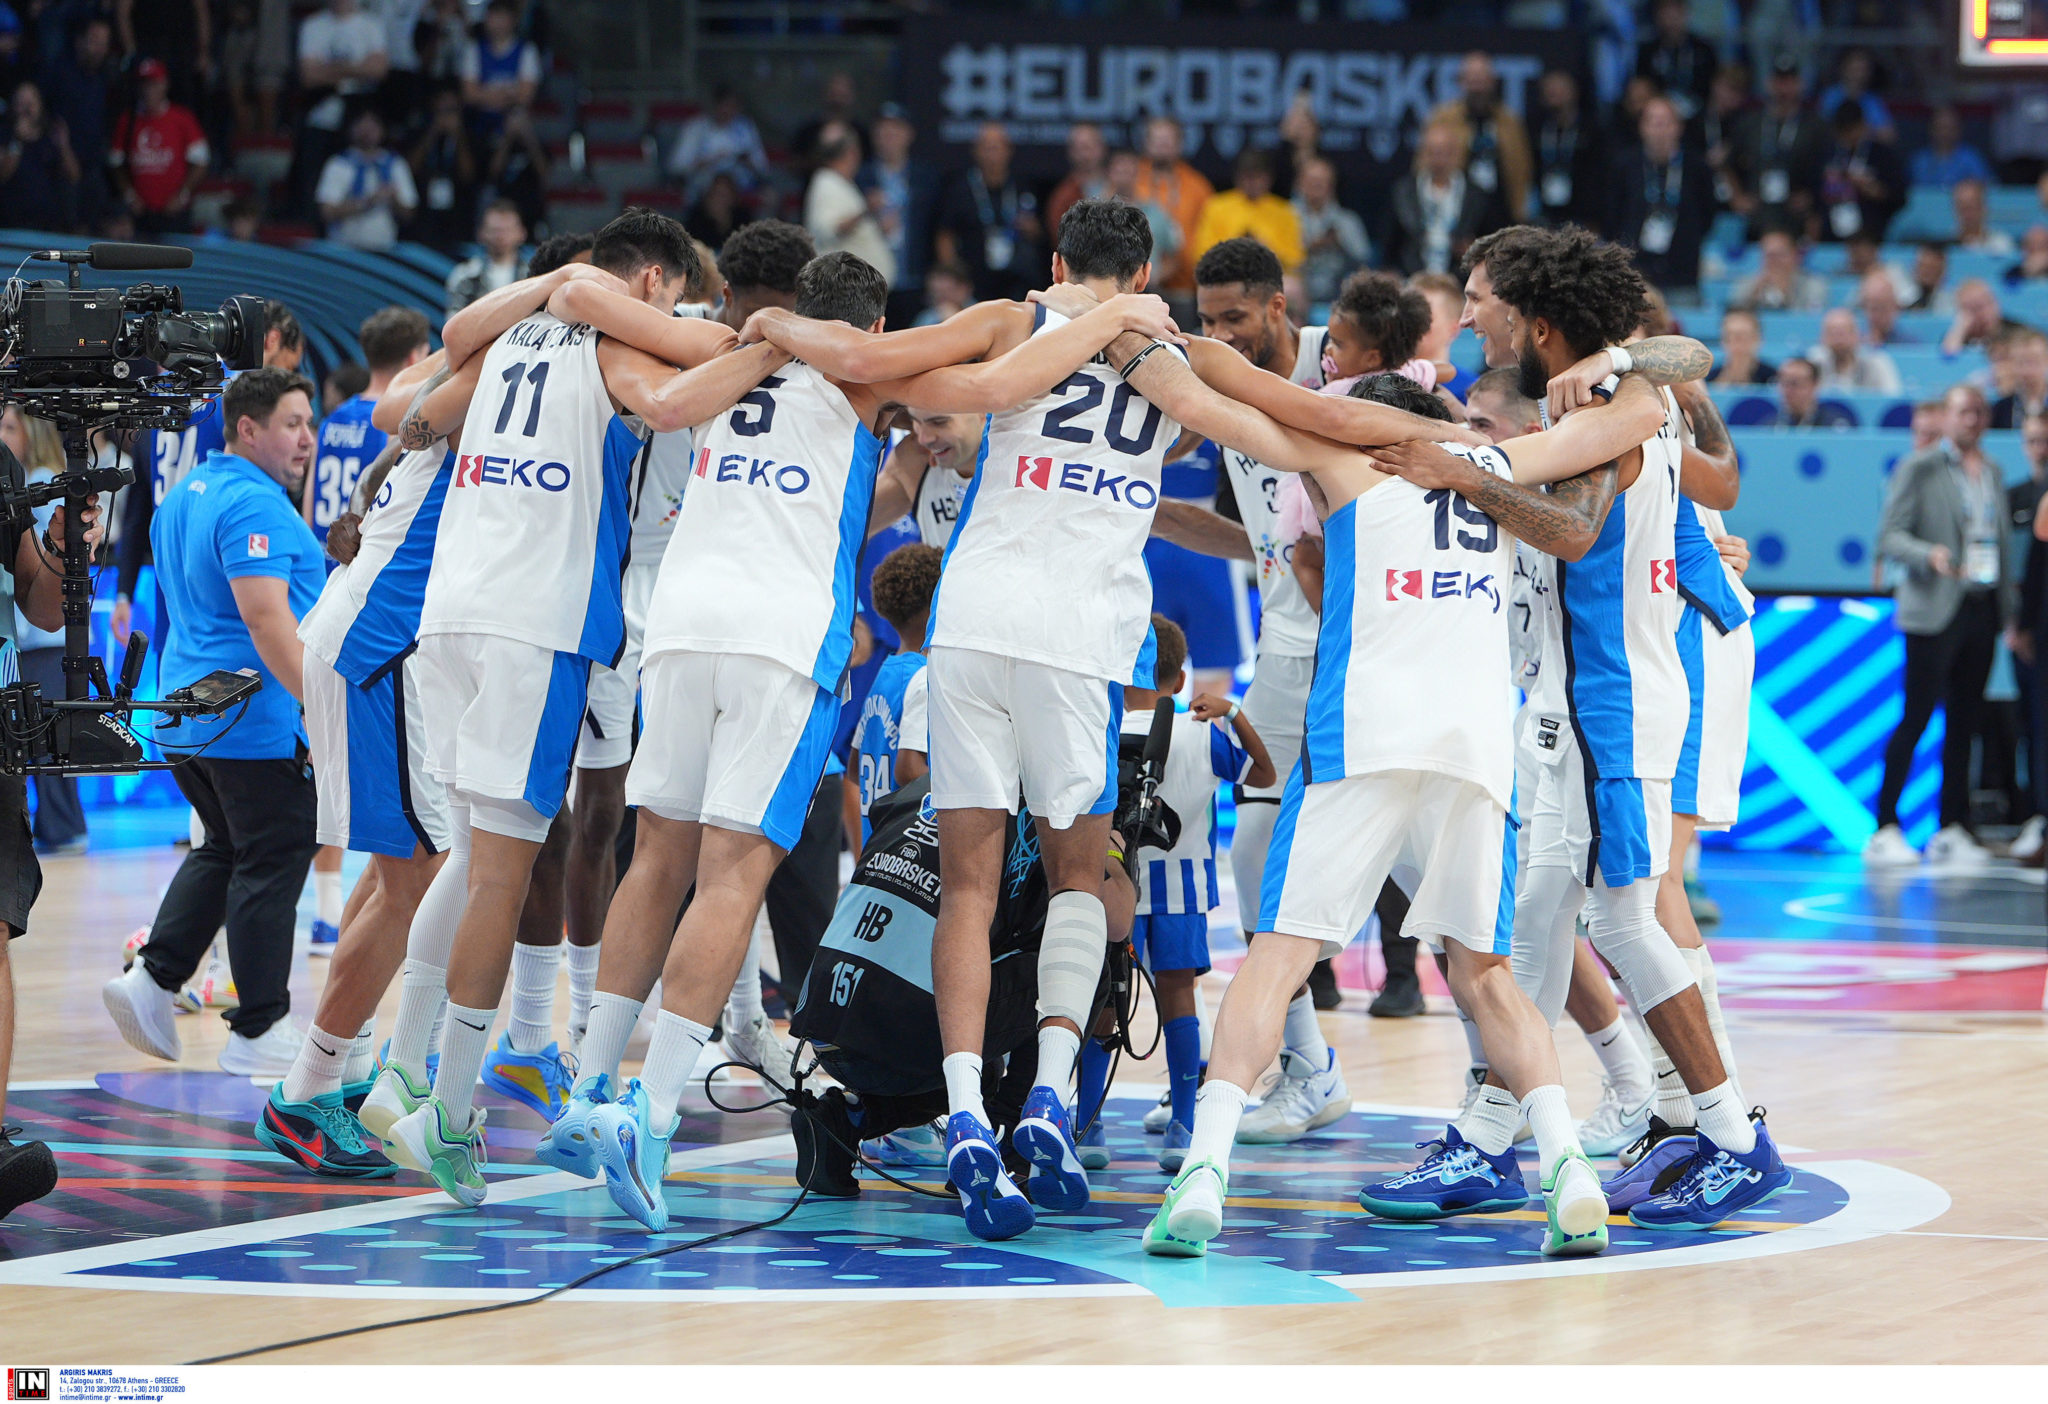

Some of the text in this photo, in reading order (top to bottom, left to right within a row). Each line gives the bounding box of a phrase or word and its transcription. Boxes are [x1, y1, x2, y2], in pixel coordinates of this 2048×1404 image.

[494, 362, 550, 438] 11
[730, 375, 787, 437] 5
[1041, 371, 1163, 457] 20
[481, 455, 571, 492] EKO
[716, 454, 810, 495] EKO
[1059, 463, 1157, 510] EKO
[1424, 488, 1498, 553] 15
[97, 714, 136, 747] STEADICAM
[860, 754, 891, 817] 34
[900, 846, 918, 860] FIBA
[853, 901, 893, 943] HB
[829, 961, 865, 1008] 151
